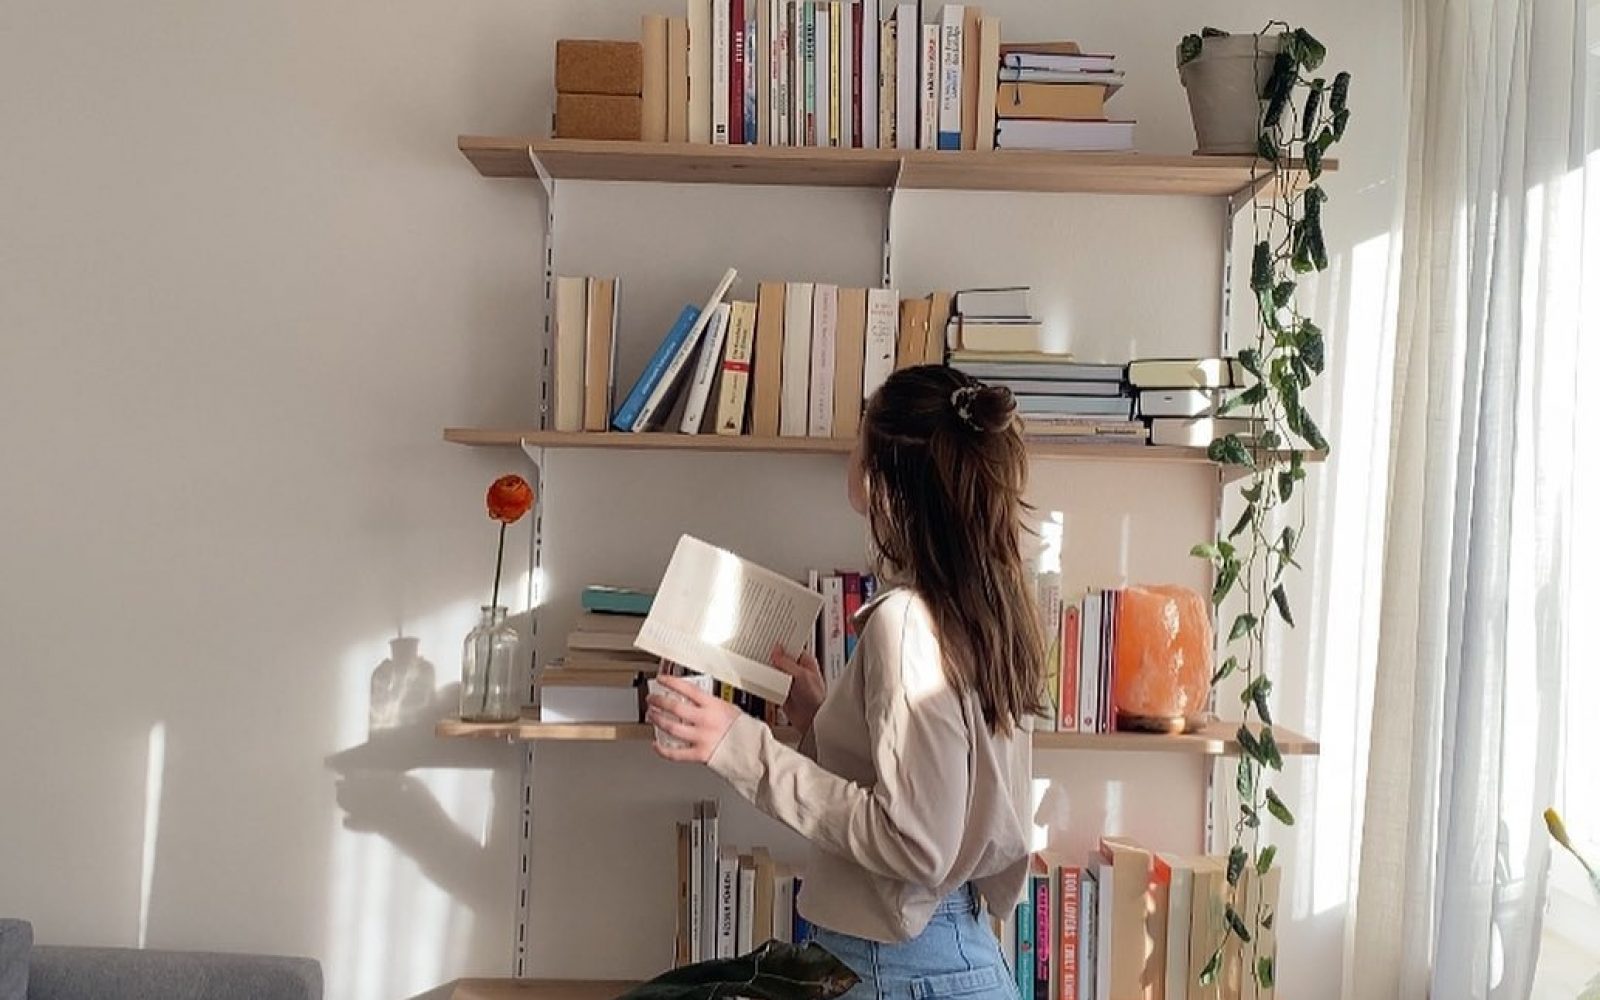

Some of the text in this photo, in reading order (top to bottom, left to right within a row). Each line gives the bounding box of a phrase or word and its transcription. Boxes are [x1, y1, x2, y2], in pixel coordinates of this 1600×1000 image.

[1064, 873, 1078, 938] BOOK LOVERS
[1064, 943, 1075, 970] EMILY
